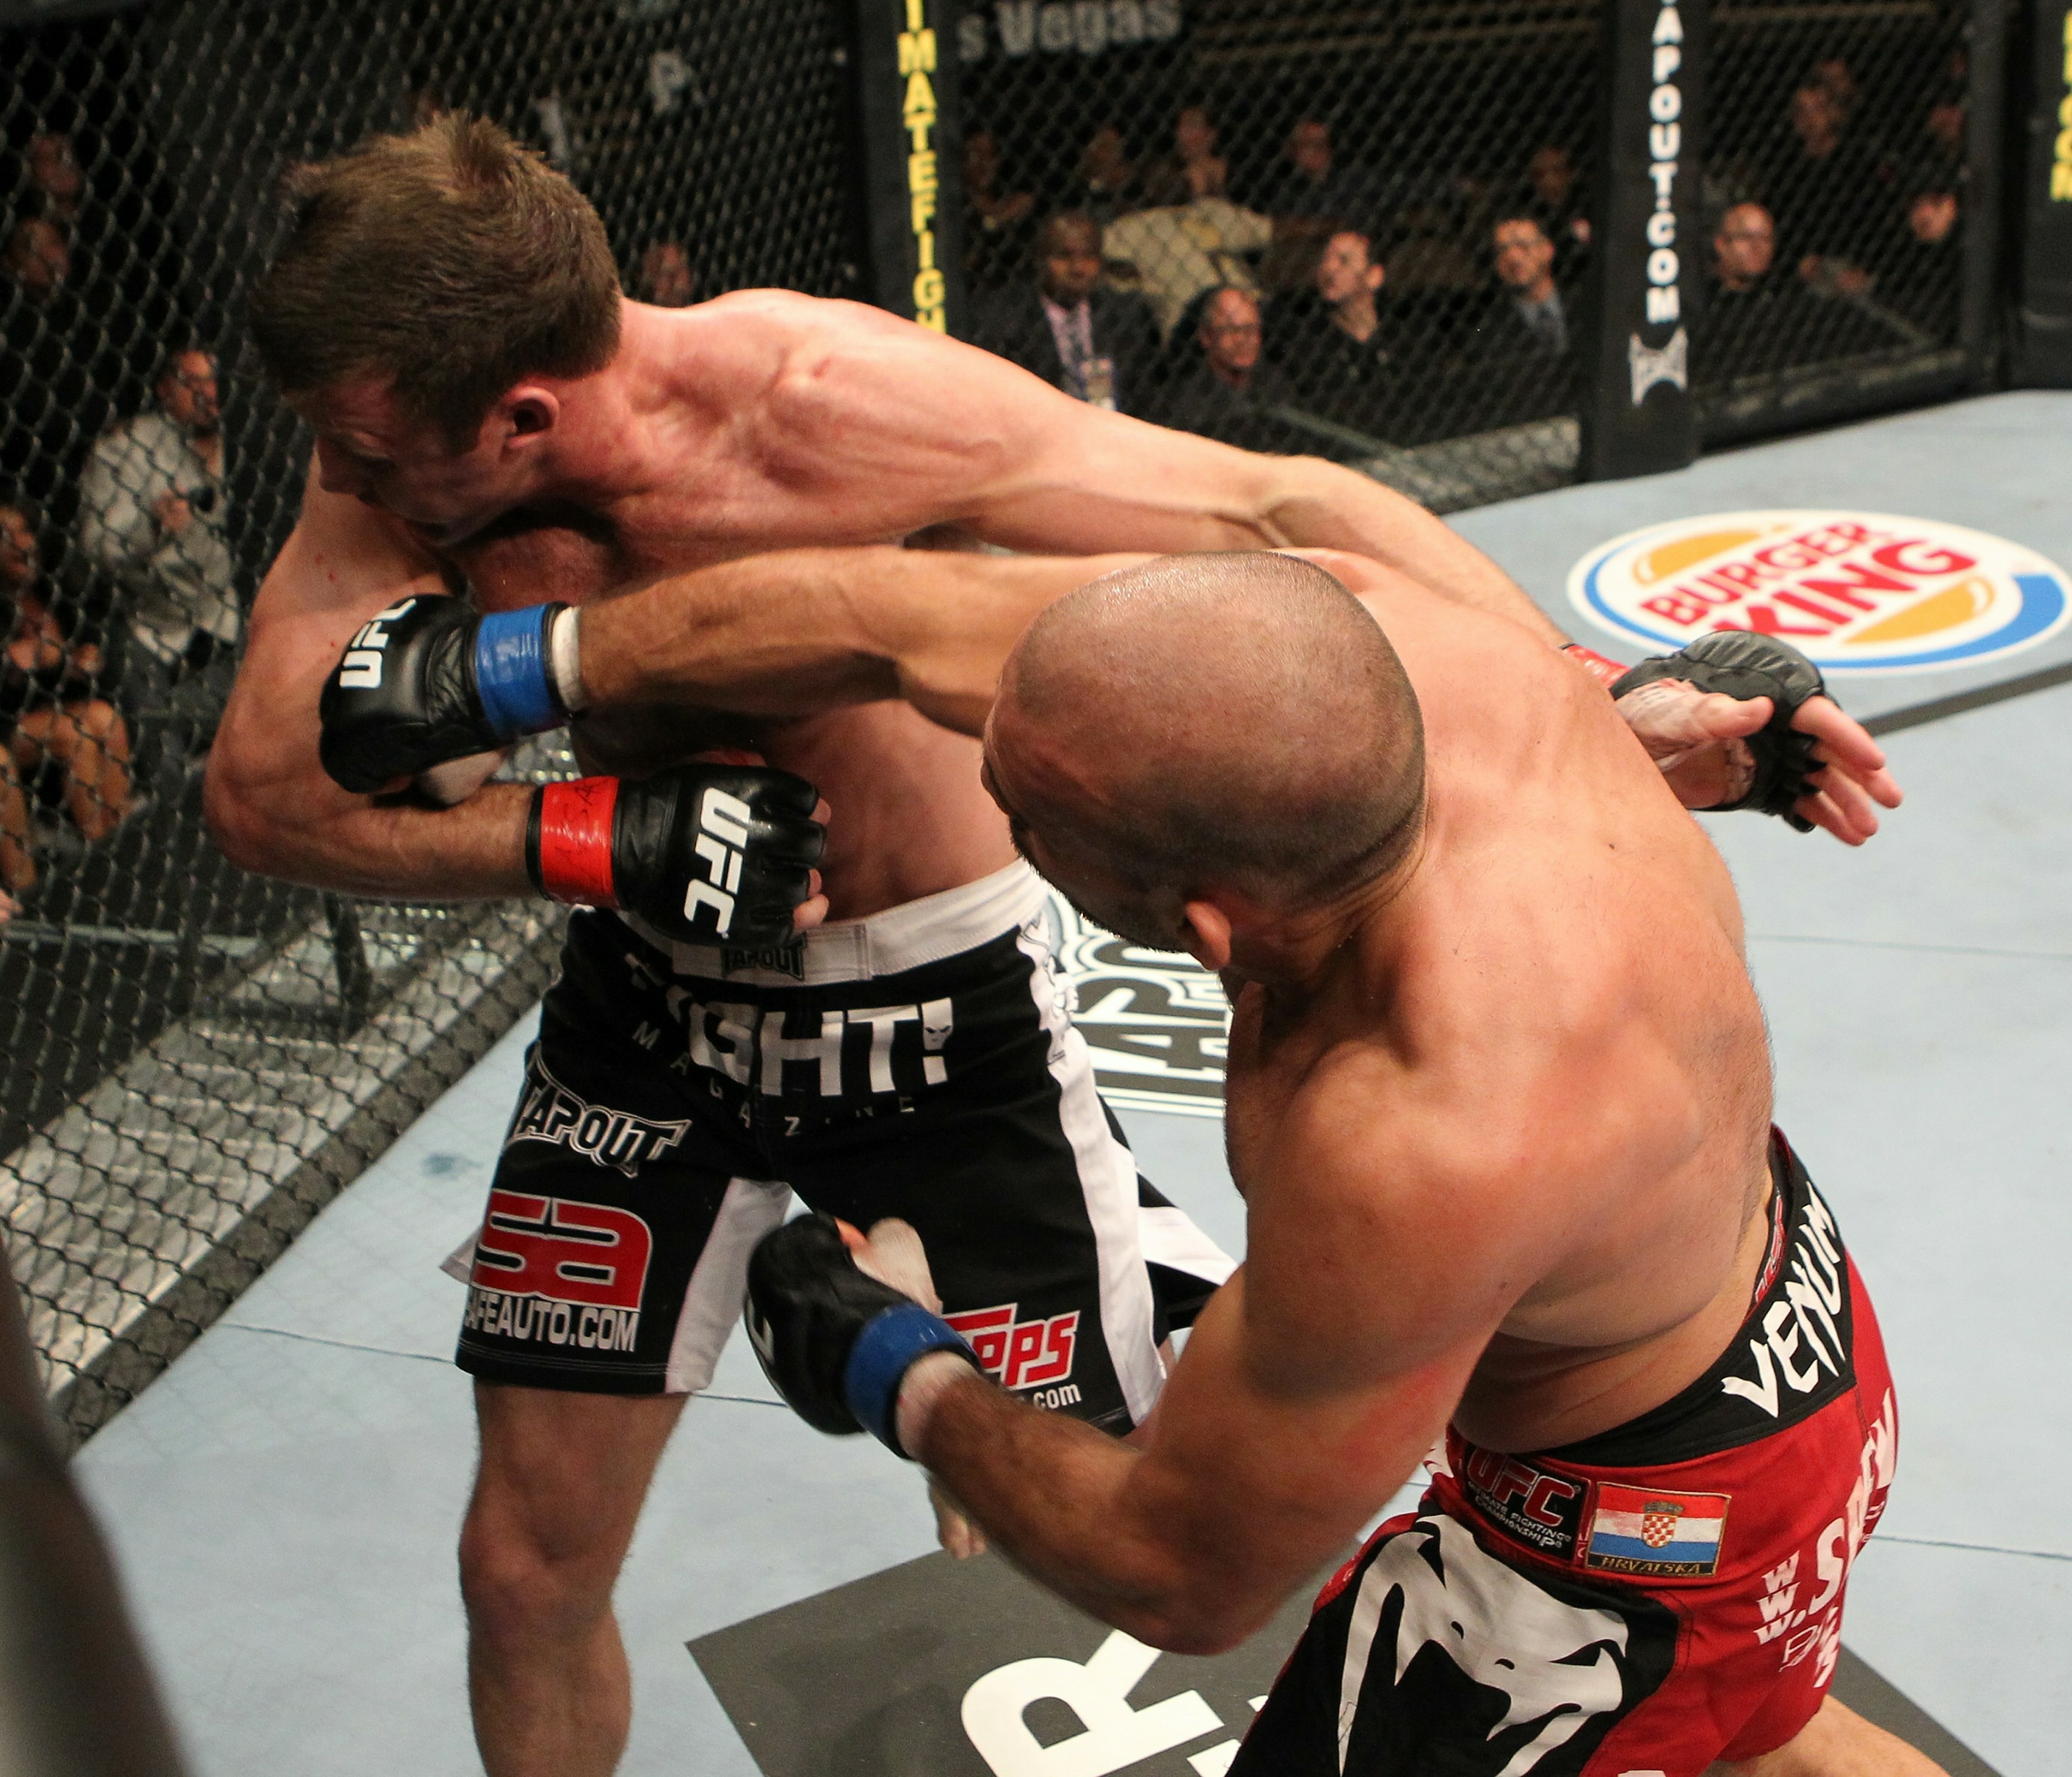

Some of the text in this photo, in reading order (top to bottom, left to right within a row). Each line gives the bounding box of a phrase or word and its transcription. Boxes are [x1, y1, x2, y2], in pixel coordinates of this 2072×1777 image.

[1645, 0, 1685, 323] APOUT.COM
[1640, 521, 1889, 626] BURGER
[1709, 539, 1977, 637] KING
[684, 787, 751, 934] UFC
[624, 952, 954, 1097] GHT!
[633, 1021, 915, 1137] MAGAZNE
[464, 1290, 640, 1352] AFEAUTO.COM
[1721, 1180, 1847, 1418] VENUM
[1467, 1448, 1576, 1528] UFC
[1474, 1495, 1557, 1547] CHAMPIONSHIP
[1510, 1512, 1566, 1541] FIGHTING
